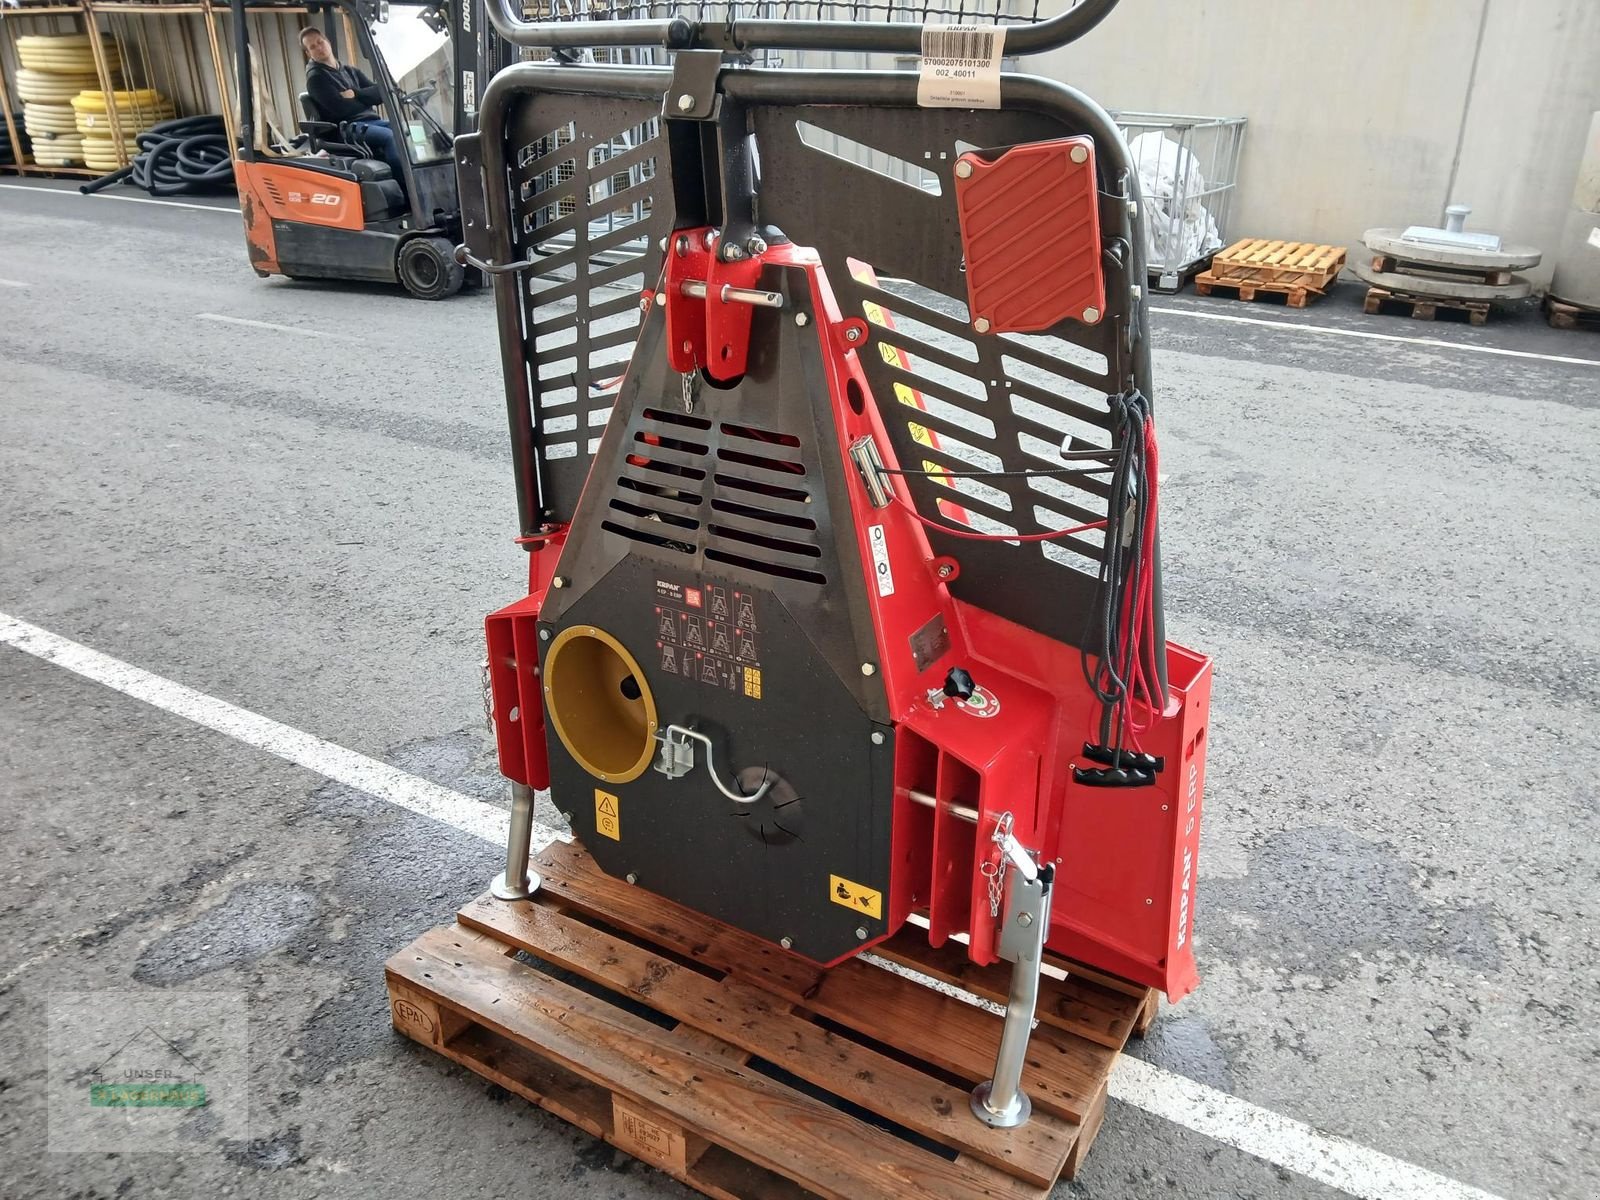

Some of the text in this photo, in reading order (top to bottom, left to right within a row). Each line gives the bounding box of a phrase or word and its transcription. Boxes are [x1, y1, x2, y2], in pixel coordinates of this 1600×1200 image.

[935, 69, 976, 79] 002_40011
[311, 193, 340, 205] 20
[1187, 764, 1198, 814] ERP
[1185, 817, 1195, 836] 5
[399, 1002, 430, 1031] EPAL
